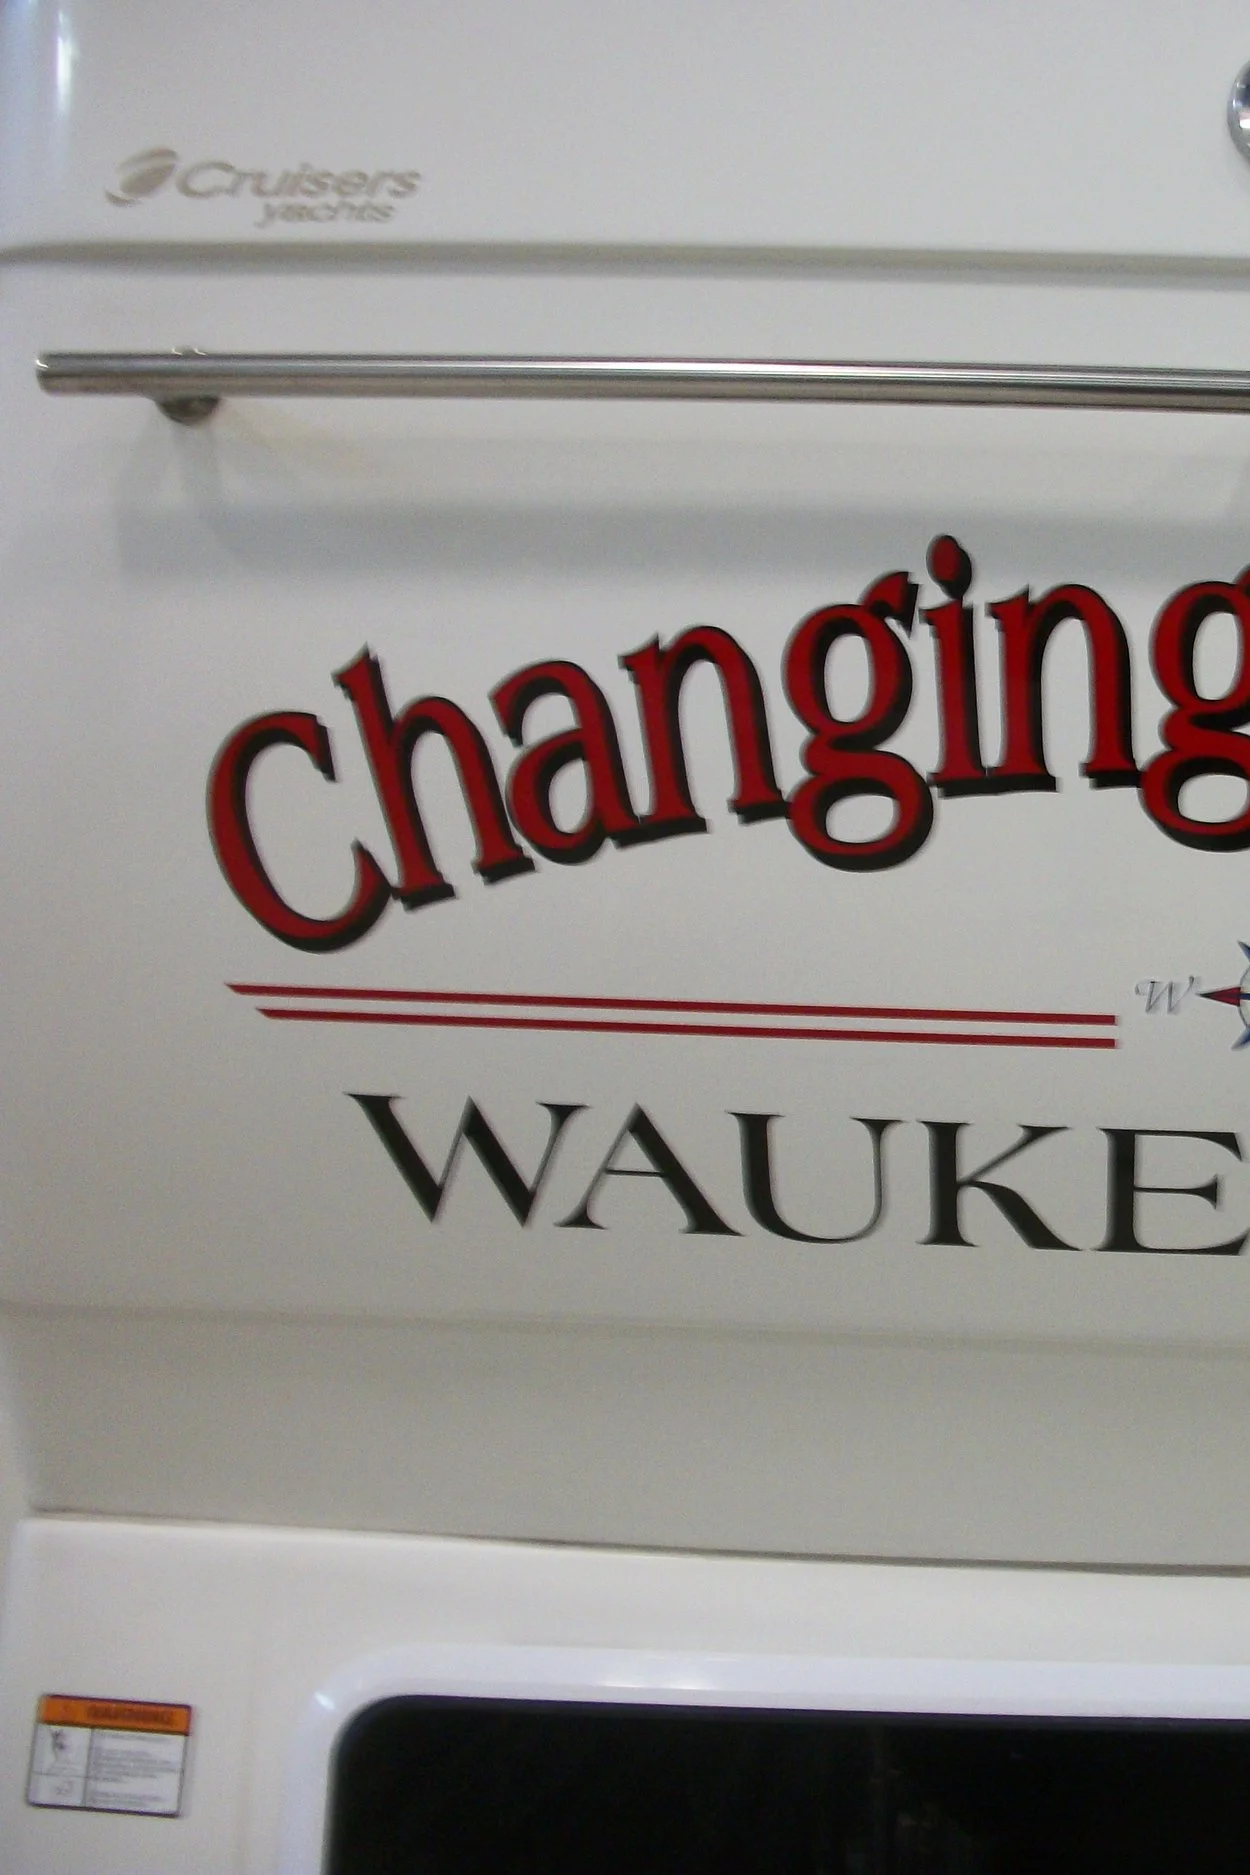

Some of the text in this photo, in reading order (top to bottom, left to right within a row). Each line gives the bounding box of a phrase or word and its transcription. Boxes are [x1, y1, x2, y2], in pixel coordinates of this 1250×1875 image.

[176, 161, 422, 199] Cruisers
[254, 202, 396, 230] yachts
[1134, 975, 1199, 1014] W
